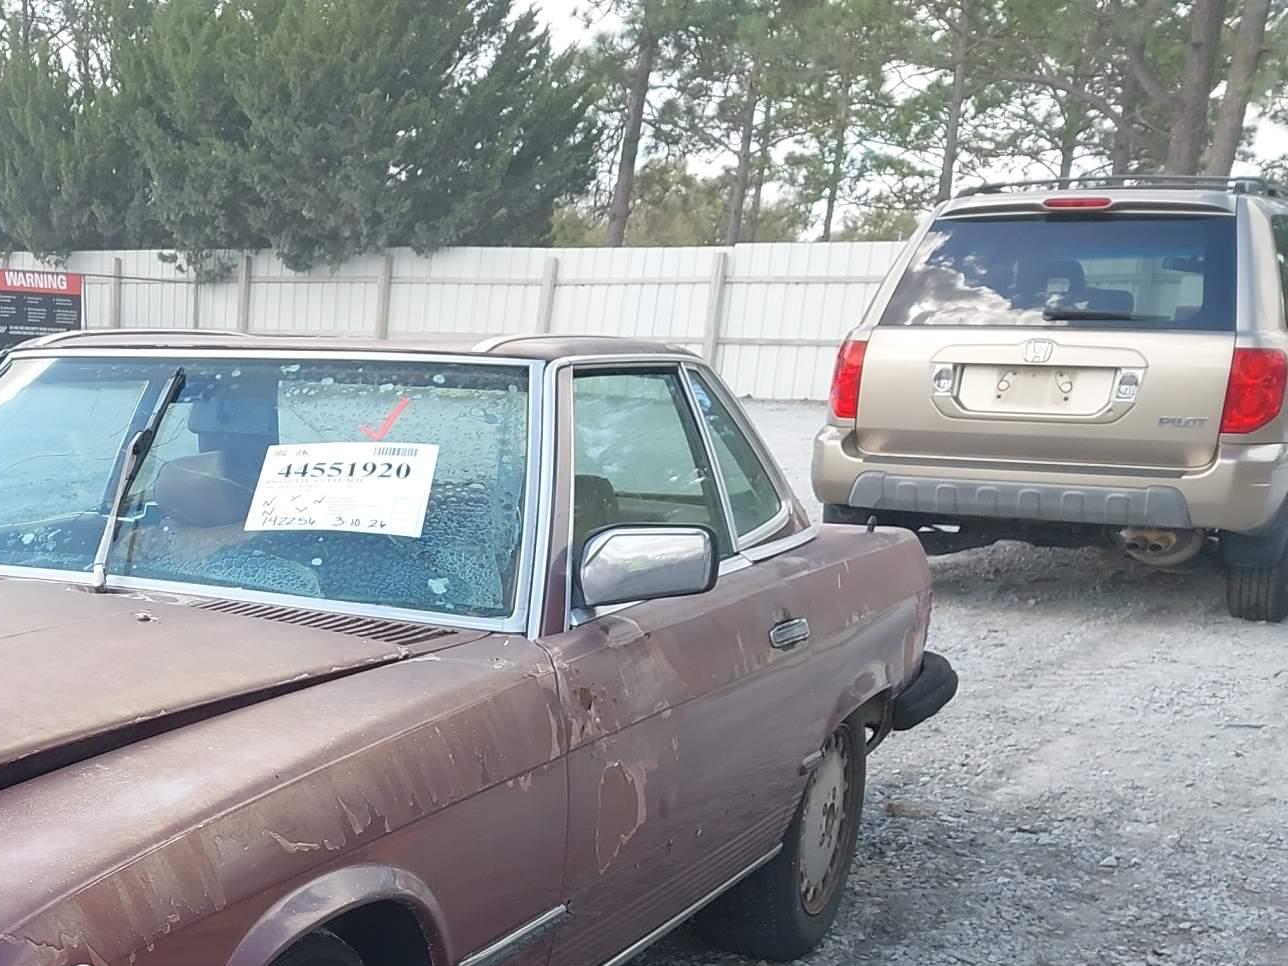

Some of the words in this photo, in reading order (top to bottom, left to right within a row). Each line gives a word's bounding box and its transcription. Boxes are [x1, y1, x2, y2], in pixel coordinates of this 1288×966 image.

[5, 271, 68, 290] WARNING
[1158, 416, 1209, 428] PILOT
[277, 462, 411, 479] 44551920
